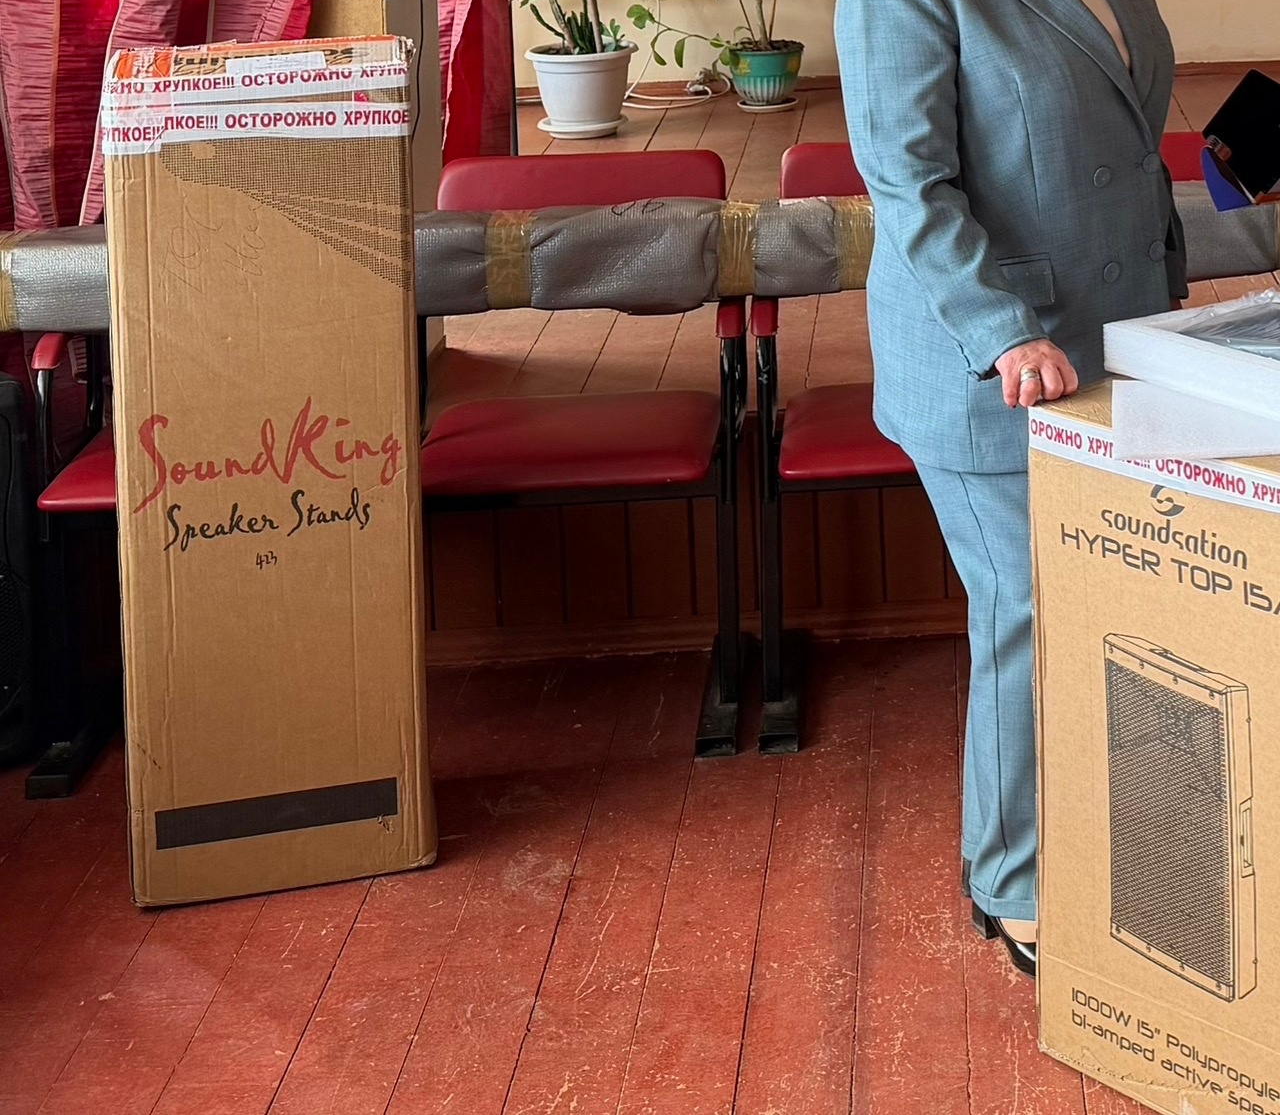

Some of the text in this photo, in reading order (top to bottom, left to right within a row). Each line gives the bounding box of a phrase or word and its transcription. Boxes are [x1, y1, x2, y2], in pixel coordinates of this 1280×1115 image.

[152, 76, 235, 93] ХРУПКОЕ!!!
[241, 69, 353, 88] ОСТОРОЖНО
[225, 111, 337, 129] ОСТОРОЖНО
[1156, 459, 1246, 495] ОСТОРОЖНО
[164, 486, 371, 552] Speaker Stands
[1101, 509, 1247, 570] soundsation
[1061, 523, 1161, 577] HYPER
[1171, 557, 1233, 595] TOP
[1071, 987, 1131, 1027] 1000W
[1137, 1018, 1160, 1040] 15"
[1071, 1009, 1154, 1062] bi-amped
[1160, 1058, 1224, 1095] active
